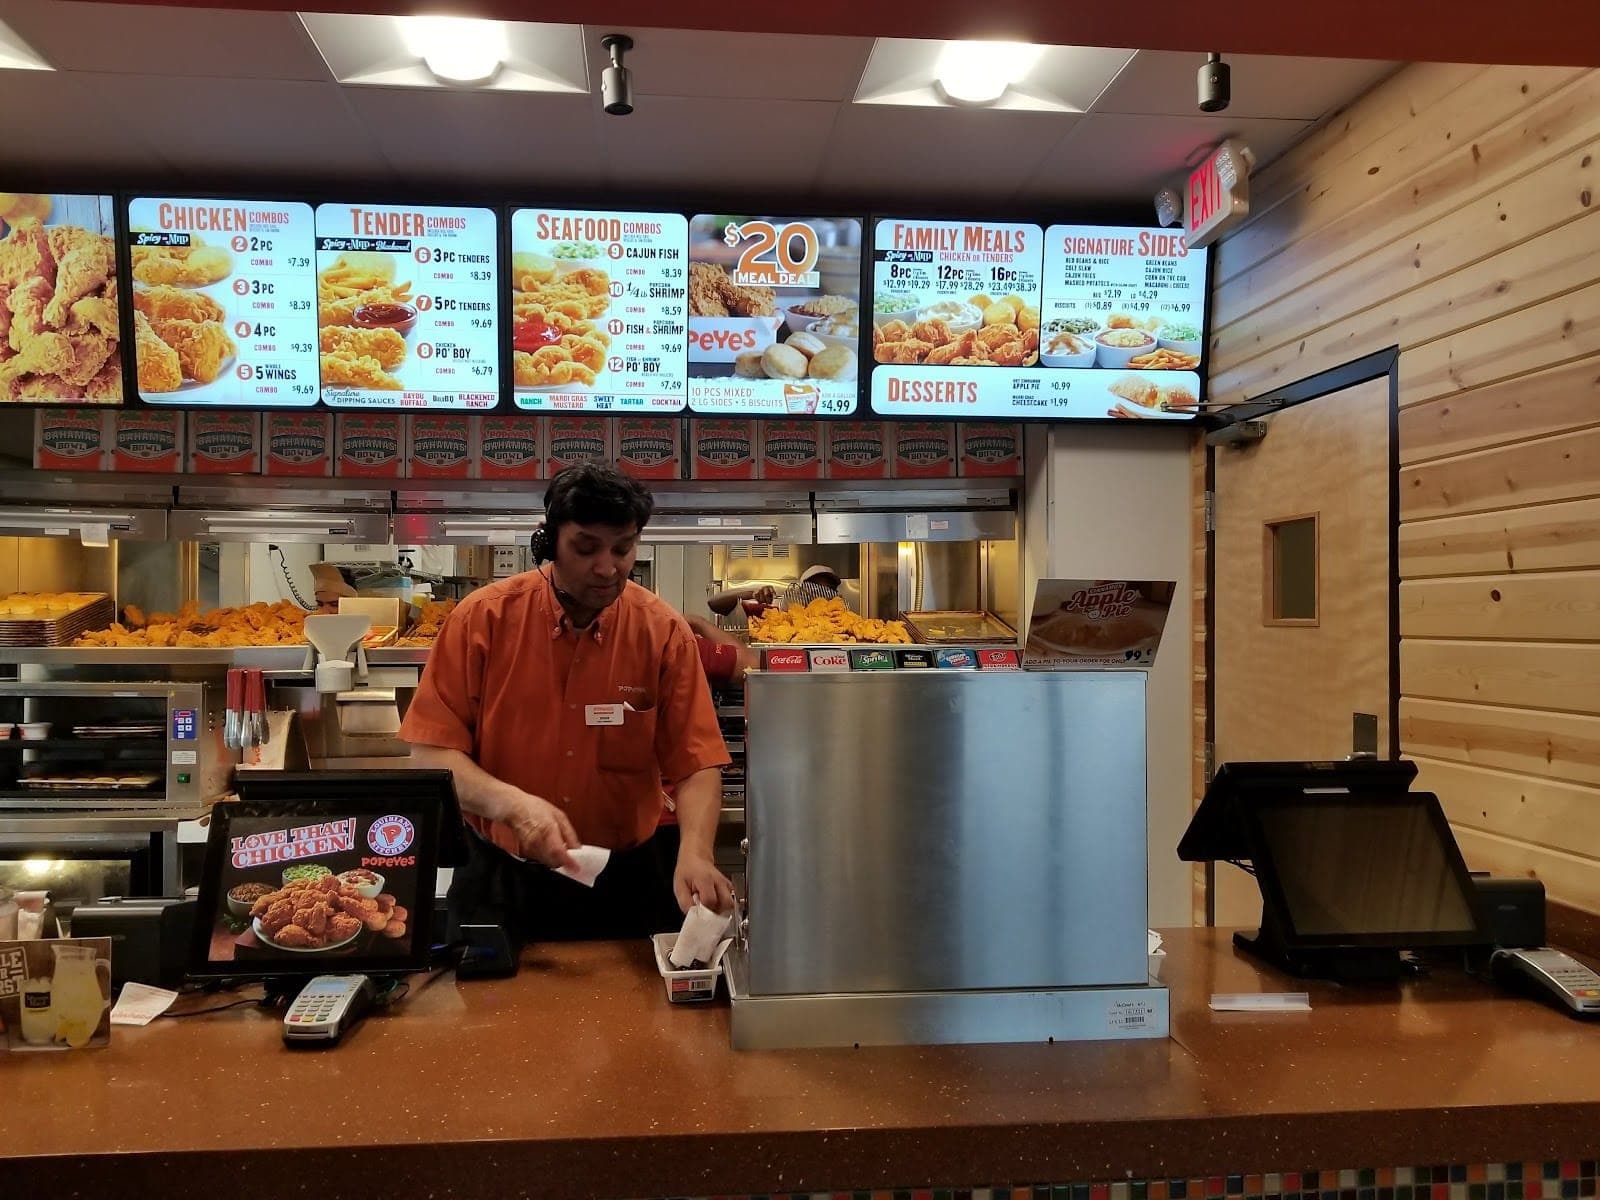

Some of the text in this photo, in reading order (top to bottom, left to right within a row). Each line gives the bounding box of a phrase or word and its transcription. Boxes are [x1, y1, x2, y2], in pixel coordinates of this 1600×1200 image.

[1190, 152, 1220, 231] EXIT
[160, 203, 289, 232] CHICKEN COMBOS
[351, 209, 424, 236] TENDER
[427, 218, 466, 229] COMBOS
[537, 214, 621, 242] SEAFOOD
[623, 222, 661, 234] COMBOS
[894, 224, 1025, 253] FAMILY MEALS
[724, 221, 819, 274] $20
[1064, 231, 1188, 257] SIGNATURE SIDES
[626, 248, 679, 259] CAJUN FISH
[939, 252, 970, 262] CHICKEN
[982, 254, 1013, 263] TENDERS
[288, 258, 310, 266] $7.39
[458, 255, 490, 264] TENDERS
[470, 272, 492, 280] $8.39
[662, 269, 682, 278] $8.39
[738, 272, 812, 285] MEAL DEAL
[883, 280, 906, 288] $12.99
[936, 281, 958, 290] $17.99
[650, 288, 685, 298] SHRIMP
[1104, 289, 1122, 298] $2.19
[289, 301, 310, 310] $8.39
[459, 302, 491, 311] TENDERS
[662, 306, 682, 315] $8.59
[1093, 301, 1112, 310] $0.89
[1130, 302, 1149, 311] $4.99
[1172, 304, 1190, 312] $6.99
[471, 319, 492, 328] $9.69
[627, 324, 683, 334] FISH SHRIMP
[291, 344, 312, 352] $9.39
[661, 344, 682, 352] $9.69
[453, 349, 471, 358] BOY
[472, 367, 493, 375] $6.79
[644, 363, 661, 372] BOY
[256, 366, 296, 380] 5 WINGS
[292, 385, 314, 394] $9.69
[661, 381, 681, 390] $7.49
[888, 378, 978, 403] DESSERTS
[1051, 382, 1070, 390] $0.99
[705, 388, 721, 396] PCS
[711, 398, 732, 406] SIDES
[749, 399, 783, 407] BISCUITS
[821, 400, 850, 412] $4.99
[1051, 398, 1068, 406] $1.99
[344, 440, 397, 451] BAHAMAS
[415, 440, 467, 451] BAHAMAS
[485, 440, 535, 451] BAHAMAS
[552, 441, 604, 451] BAHAMAS
[622, 441, 673, 451] BAHAMAS
[700, 441, 748, 451] BAHAMAS
[766, 441, 816, 451] BAHAMAS
[1068, 589, 1136, 610] Apple
[1102, 604, 1130, 618] Pie
[861, 655, 887, 665] Sprite
[1125, 650, 1141, 660] 99
[813, 656, 846, 665] Coke
[370, 816, 412, 832] LOUISIANA
[232, 821, 348, 851] LOVE THAT
